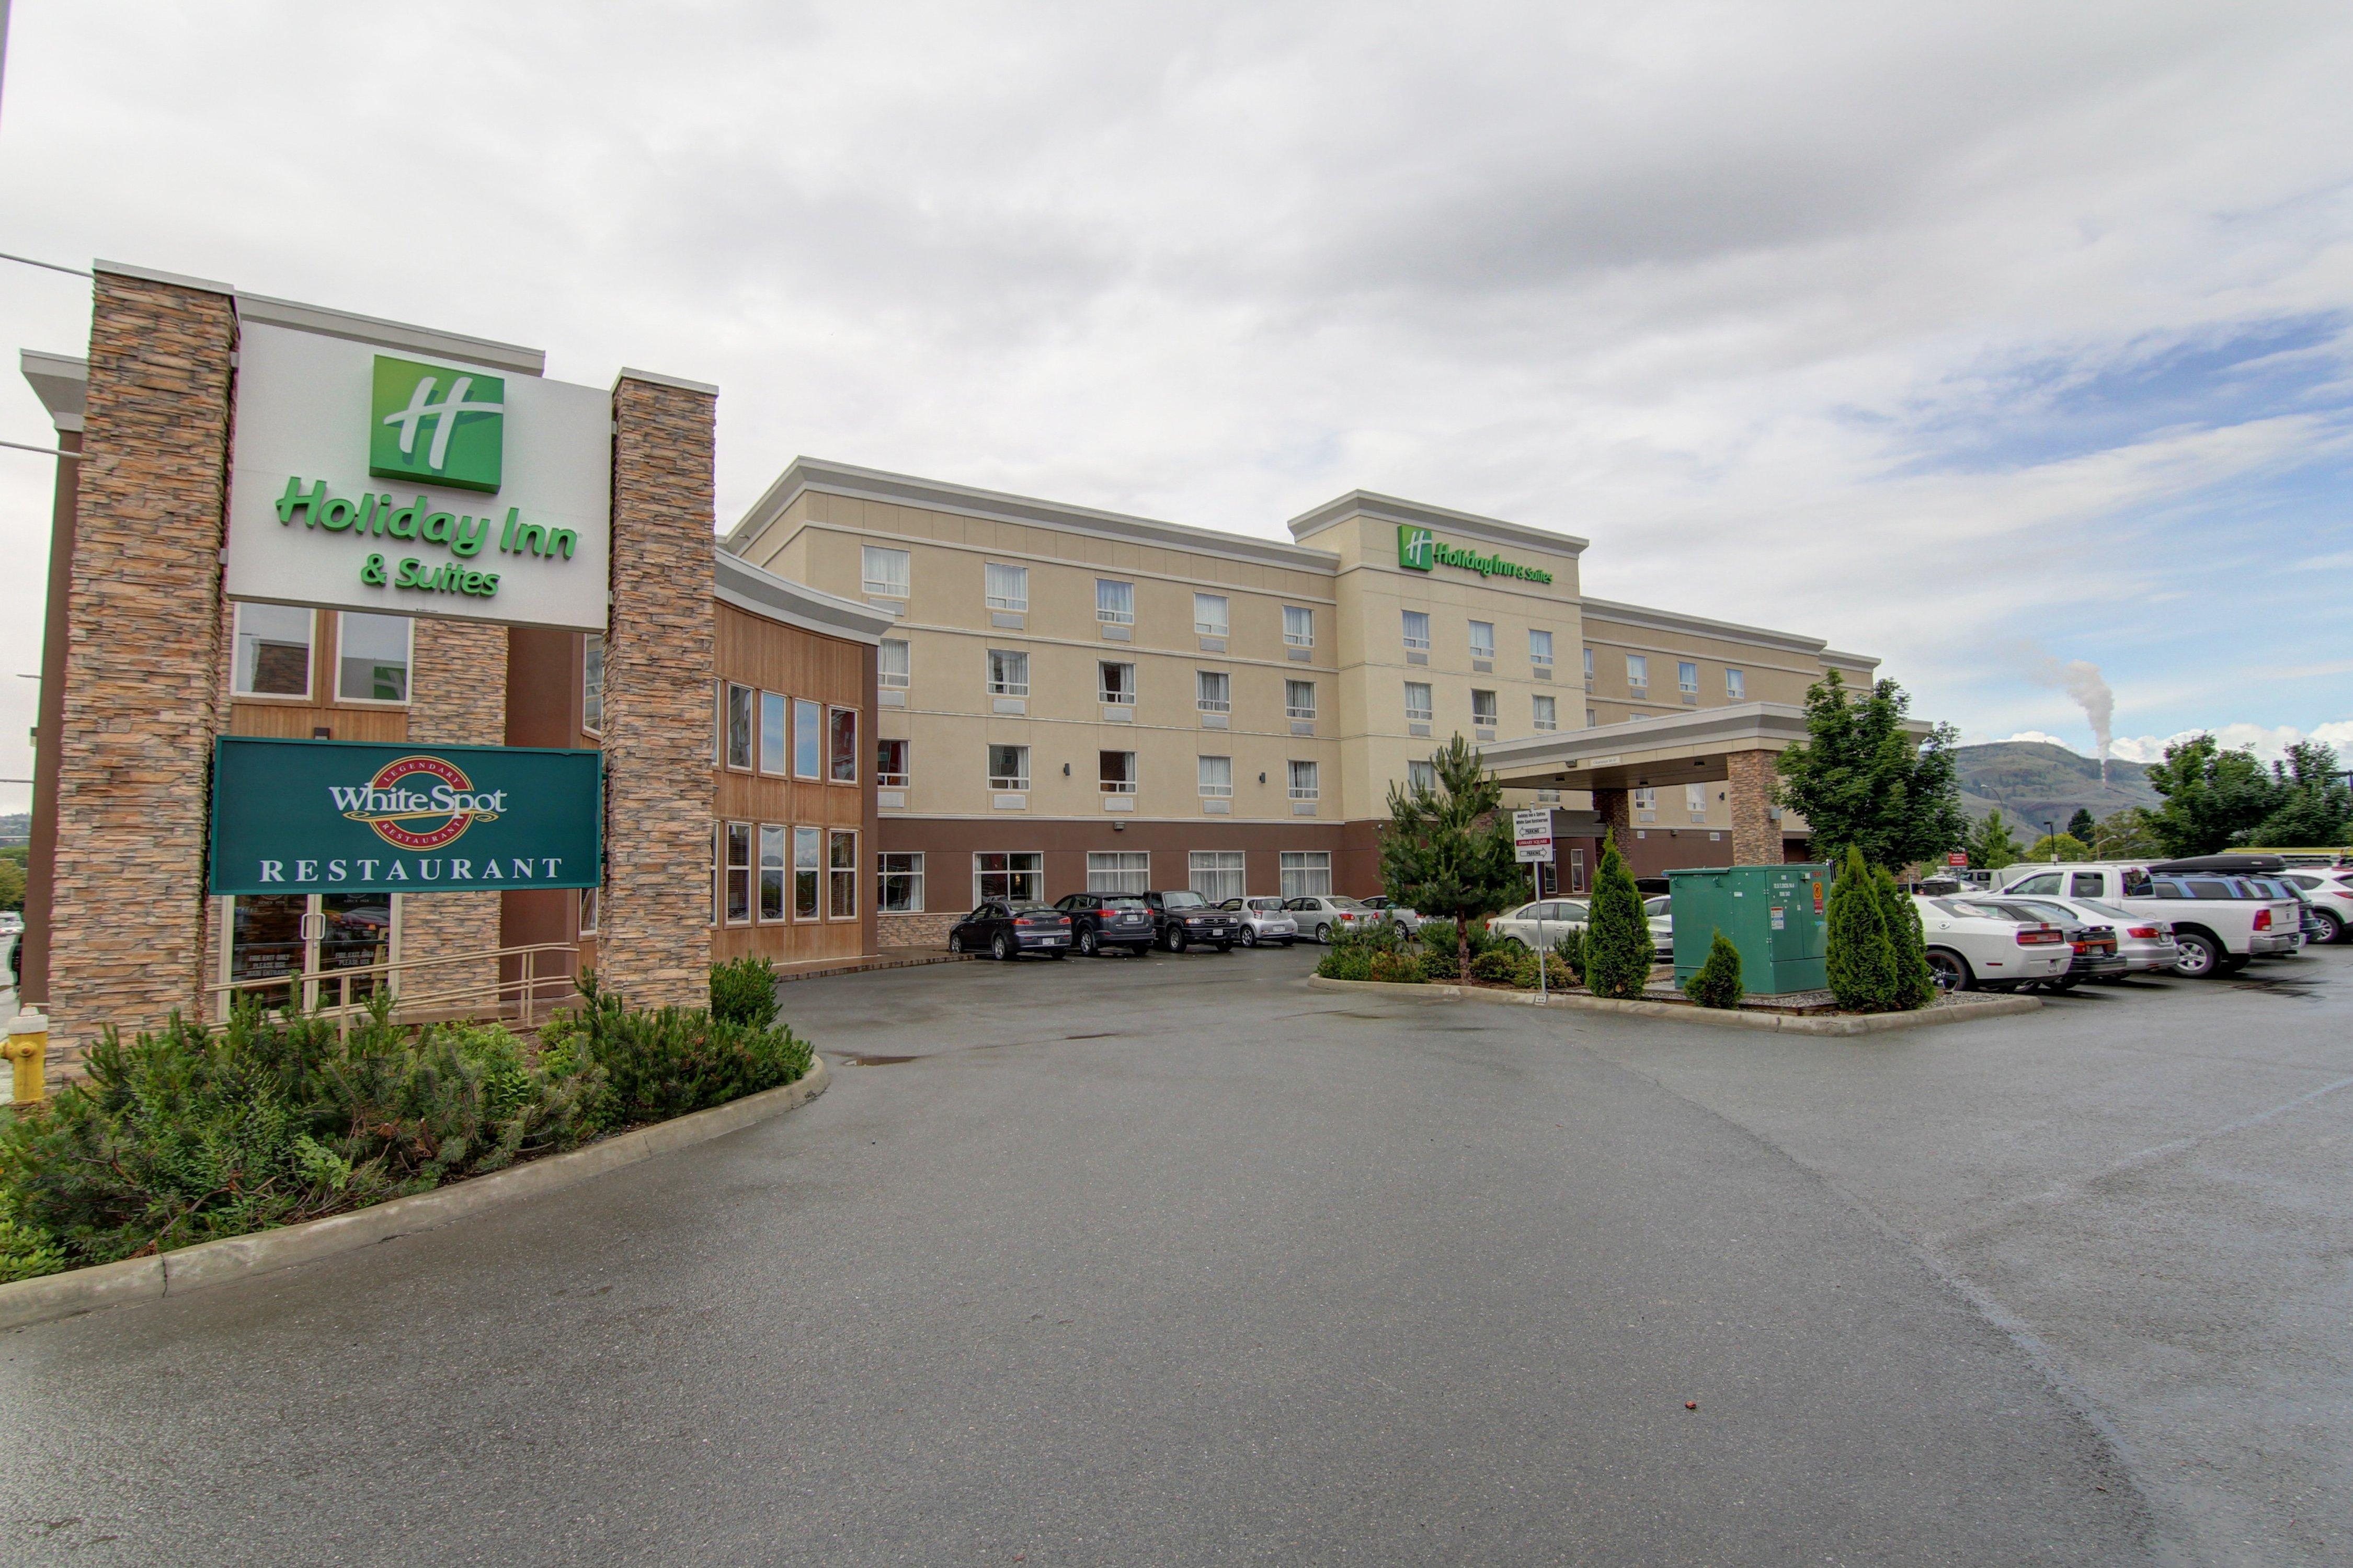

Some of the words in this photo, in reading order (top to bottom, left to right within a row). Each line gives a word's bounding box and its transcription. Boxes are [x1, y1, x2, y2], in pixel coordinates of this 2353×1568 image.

[275, 476, 490, 558] Holiday
[500, 507, 578, 559] Inn
[361, 554, 387, 587] &
[395, 557, 500, 597] Suites
[1434, 542, 1493, 577] Holiday
[1492, 554, 1516, 577] Inn
[1516, 565, 1524, 579] &
[1524, 567, 1552, 584] Suites
[383, 762, 460, 784] LEGENDARY
[382, 821, 460, 843] RESTAURANT
[259, 858, 563, 883] RESTAURANT
